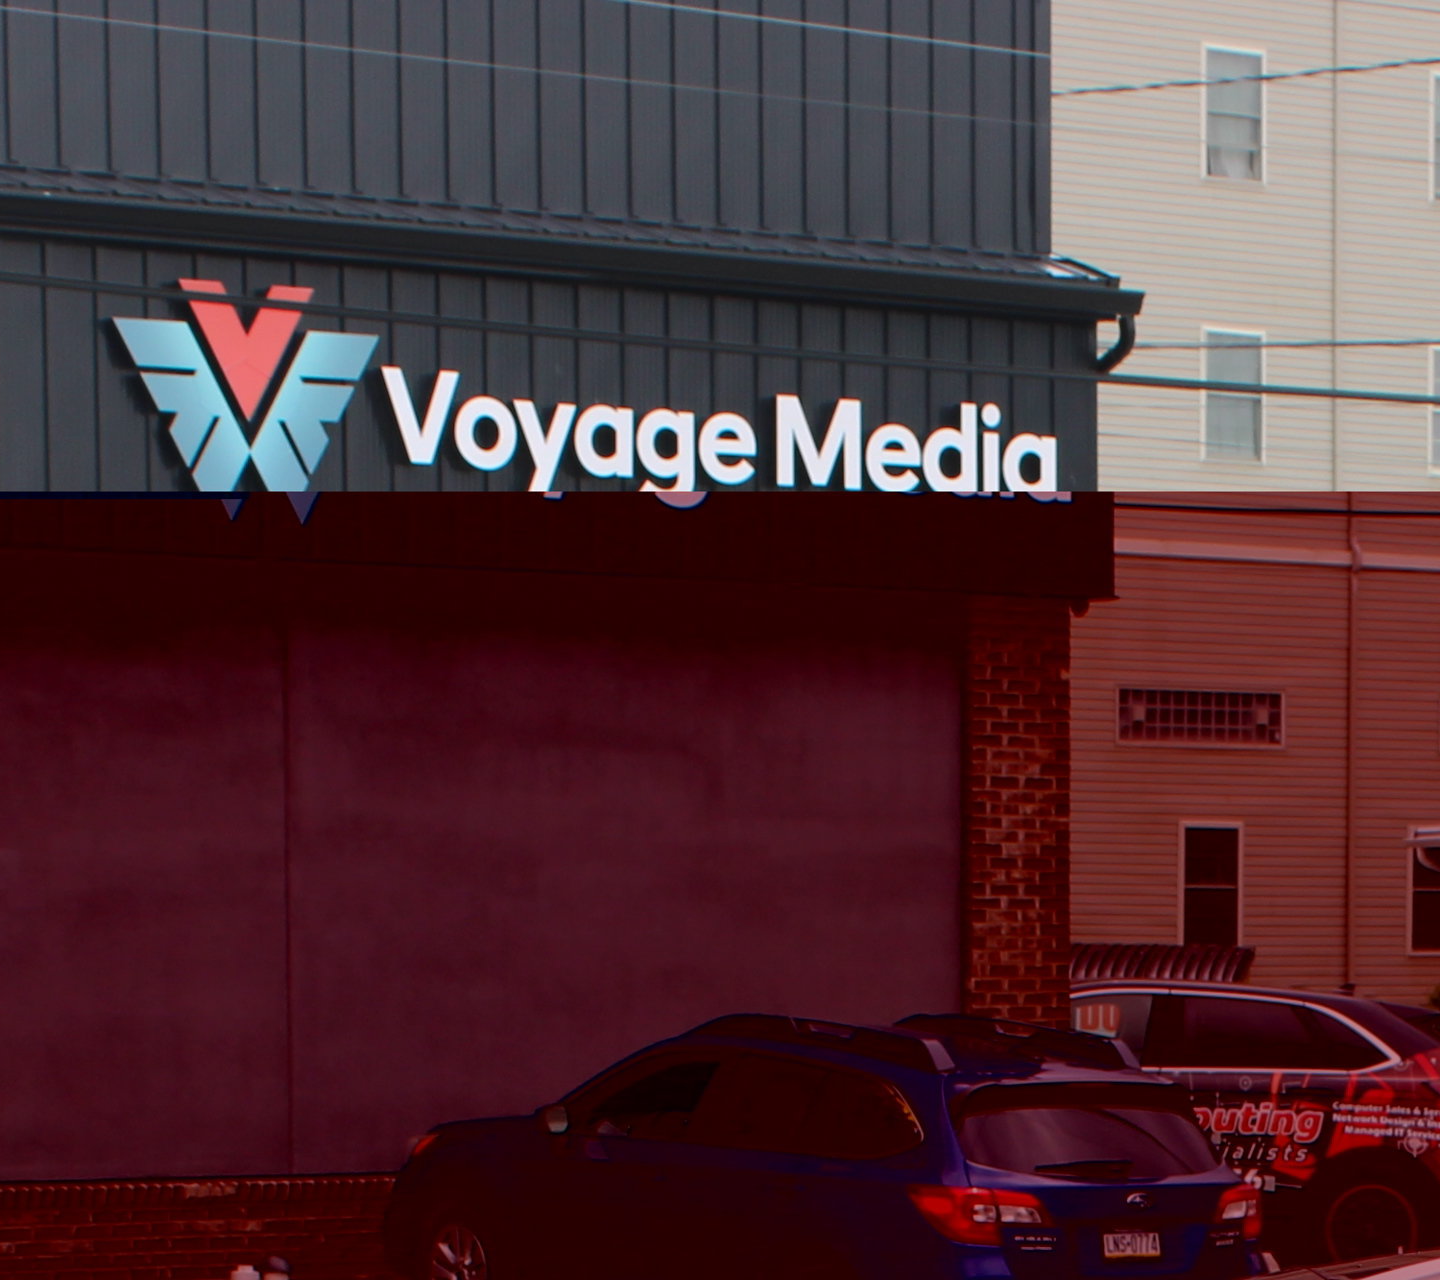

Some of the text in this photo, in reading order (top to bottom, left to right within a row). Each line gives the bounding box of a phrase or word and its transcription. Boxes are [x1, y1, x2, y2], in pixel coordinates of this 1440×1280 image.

[381, 365, 1072, 508] Voyage Media
[1332, 1101, 1383, 1113] Computer
[1386, 1104, 1411, 1115] Sales
[1332, 1113, 1378, 1123] Network
[1380, 1116, 1414, 1127] Design
[1344, 1125, 1393, 1137] Managed
[1394, 1127, 1405, 1137] IT
